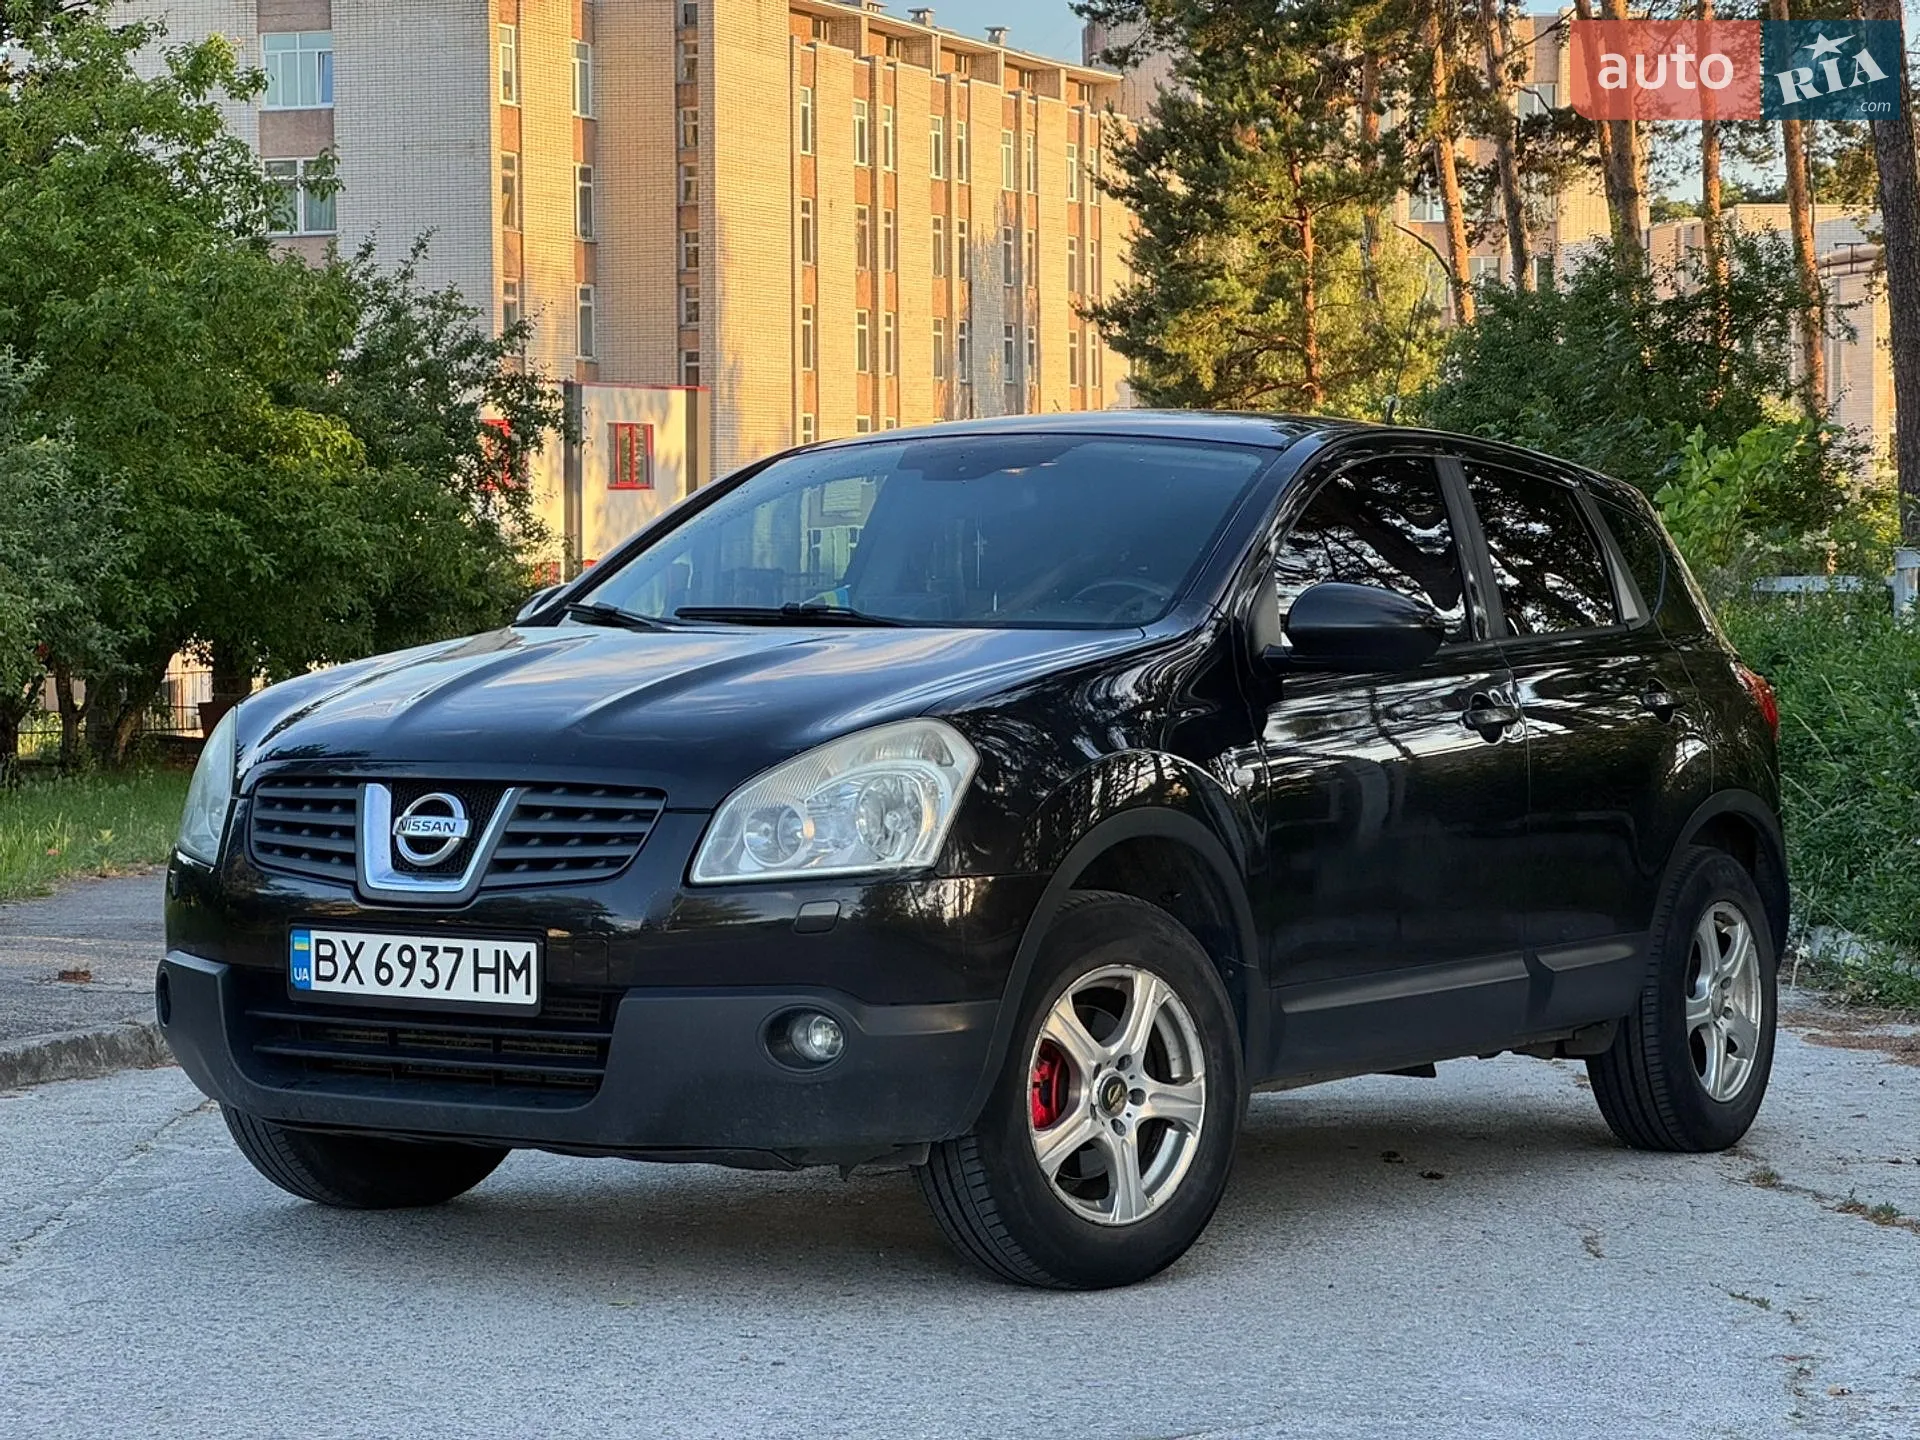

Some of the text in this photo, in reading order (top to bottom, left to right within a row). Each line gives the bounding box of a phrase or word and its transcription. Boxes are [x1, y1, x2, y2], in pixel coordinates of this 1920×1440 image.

[398, 818, 457, 833] NISSAN
[294, 967, 310, 982] UA
[314, 938, 531, 996] BX 6937 HM
